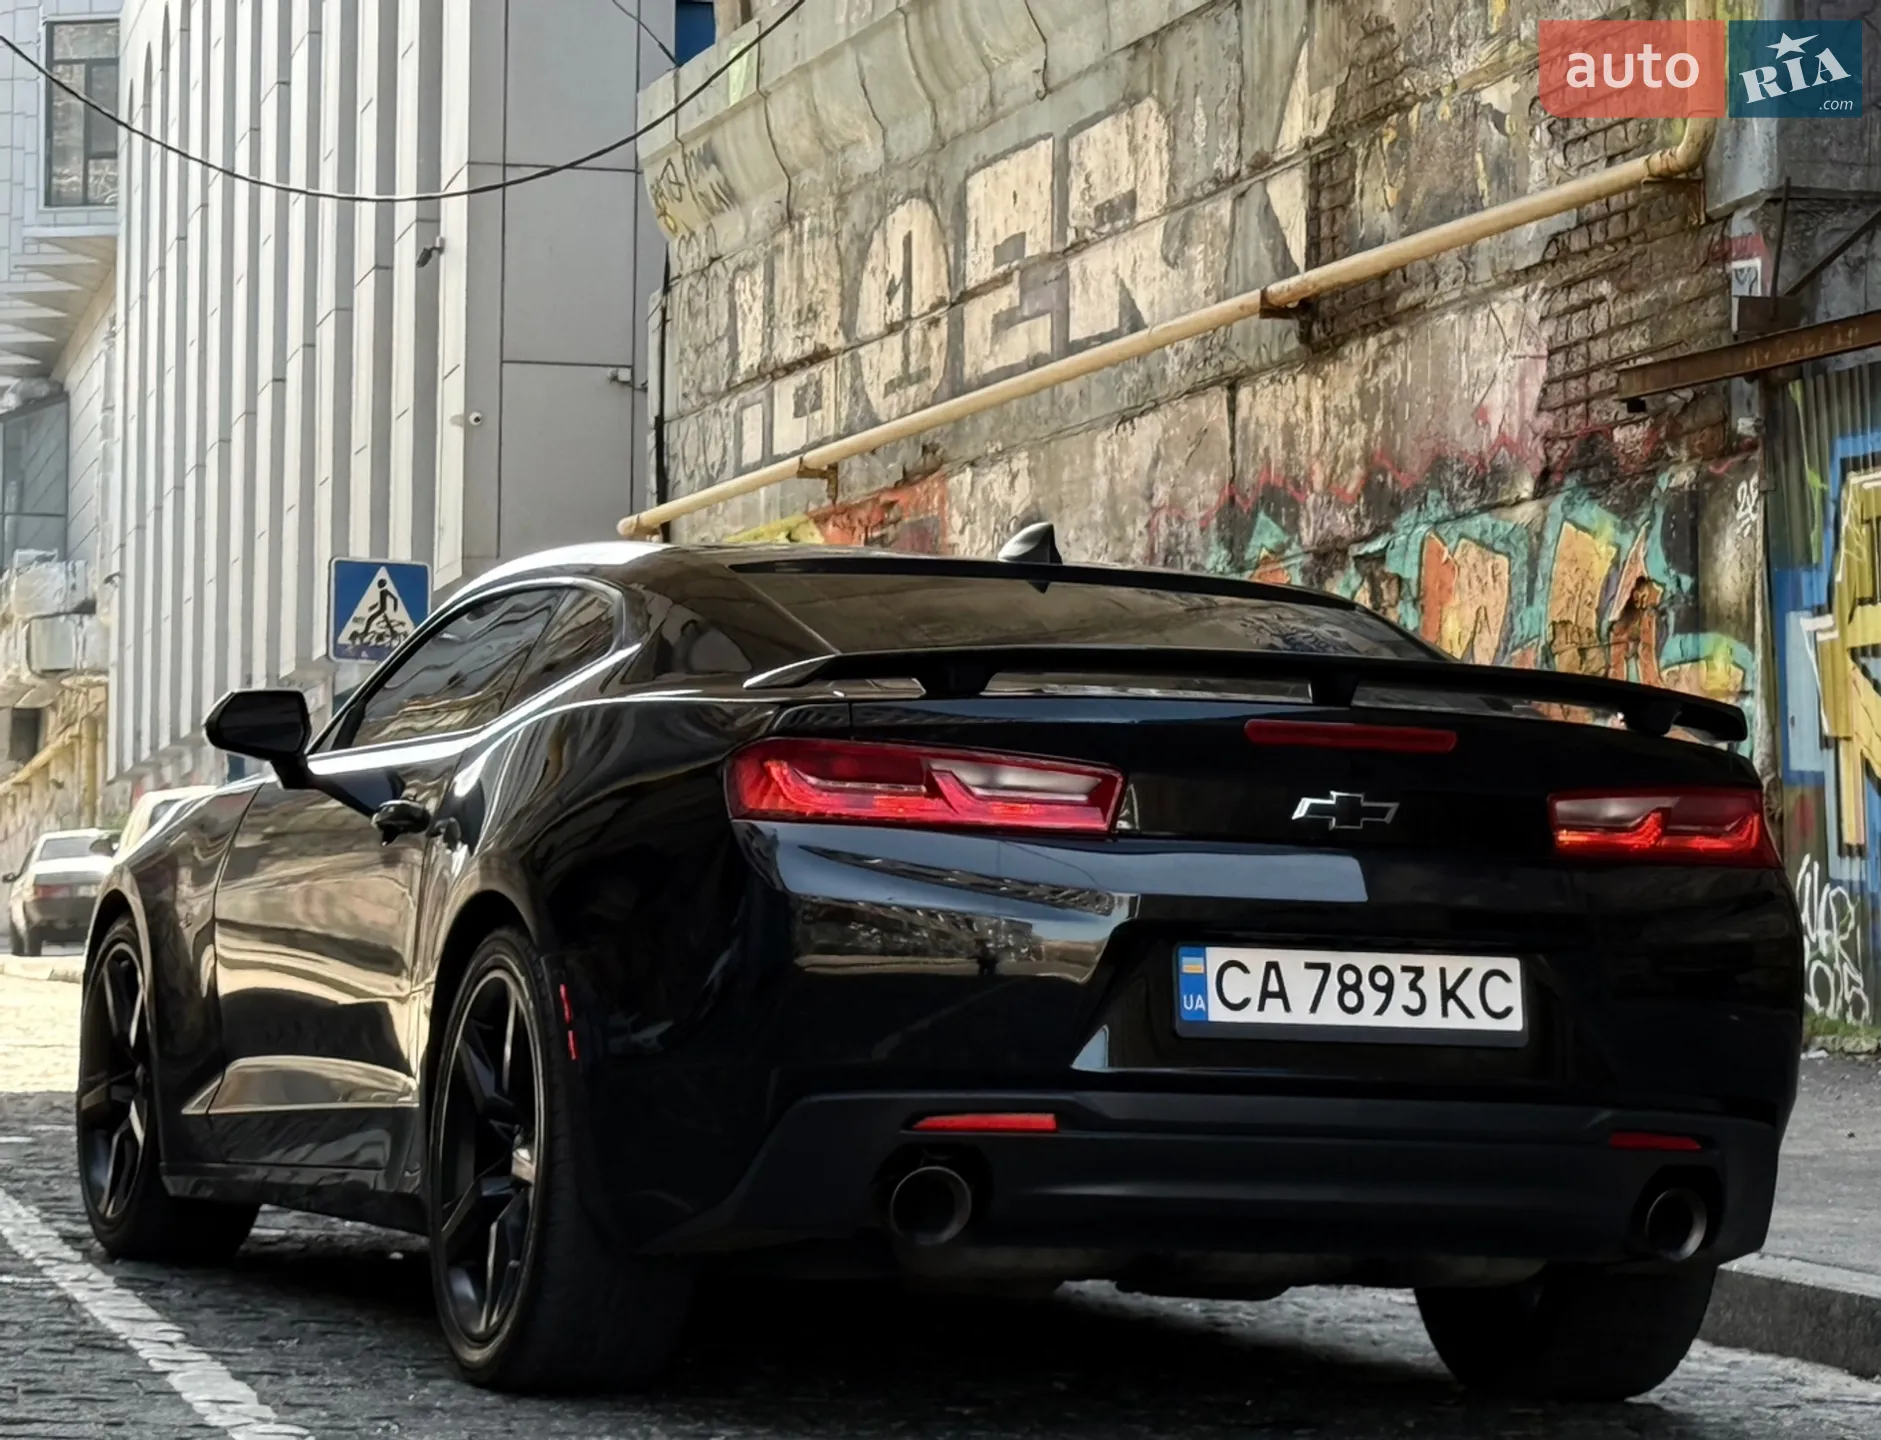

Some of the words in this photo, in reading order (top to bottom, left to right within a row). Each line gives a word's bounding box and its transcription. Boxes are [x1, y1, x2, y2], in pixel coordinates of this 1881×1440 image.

[1183, 994, 1206, 1012] UA
[1215, 959, 1292, 1013] CA
[1304, 962, 1427, 1017] 7893
[1439, 967, 1514, 1020] KC
